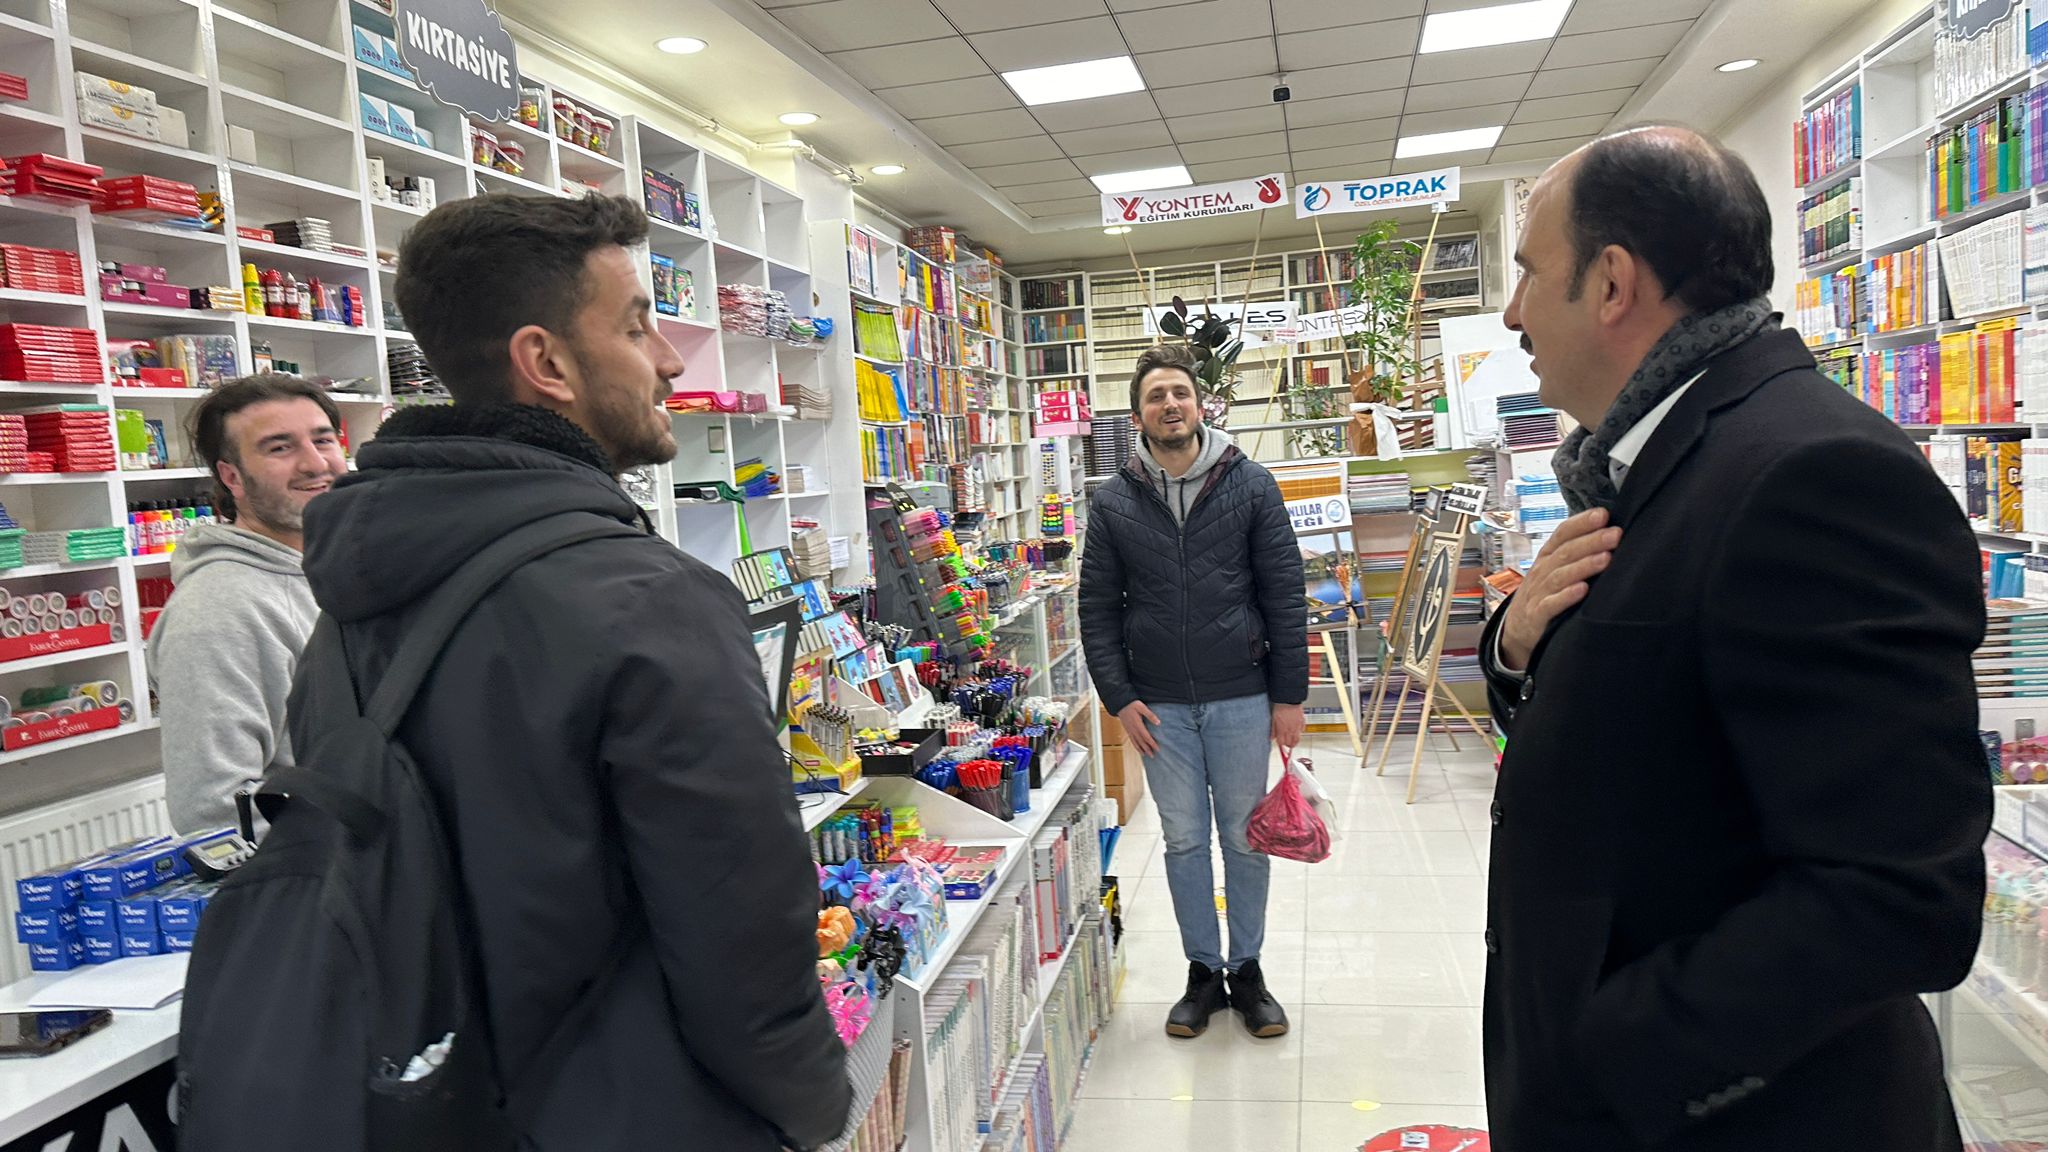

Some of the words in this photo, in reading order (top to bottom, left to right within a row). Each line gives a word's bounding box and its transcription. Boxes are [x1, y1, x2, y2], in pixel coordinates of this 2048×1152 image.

[406, 10, 511, 88] KIRTASİYE
[1344, 176, 1446, 201] TOPRAK
[1140, 213, 1180, 223] EĞİTİM
[1184, 203, 1254, 218] KURUMLARI
[1144, 192, 1233, 214] YÖNTEM
